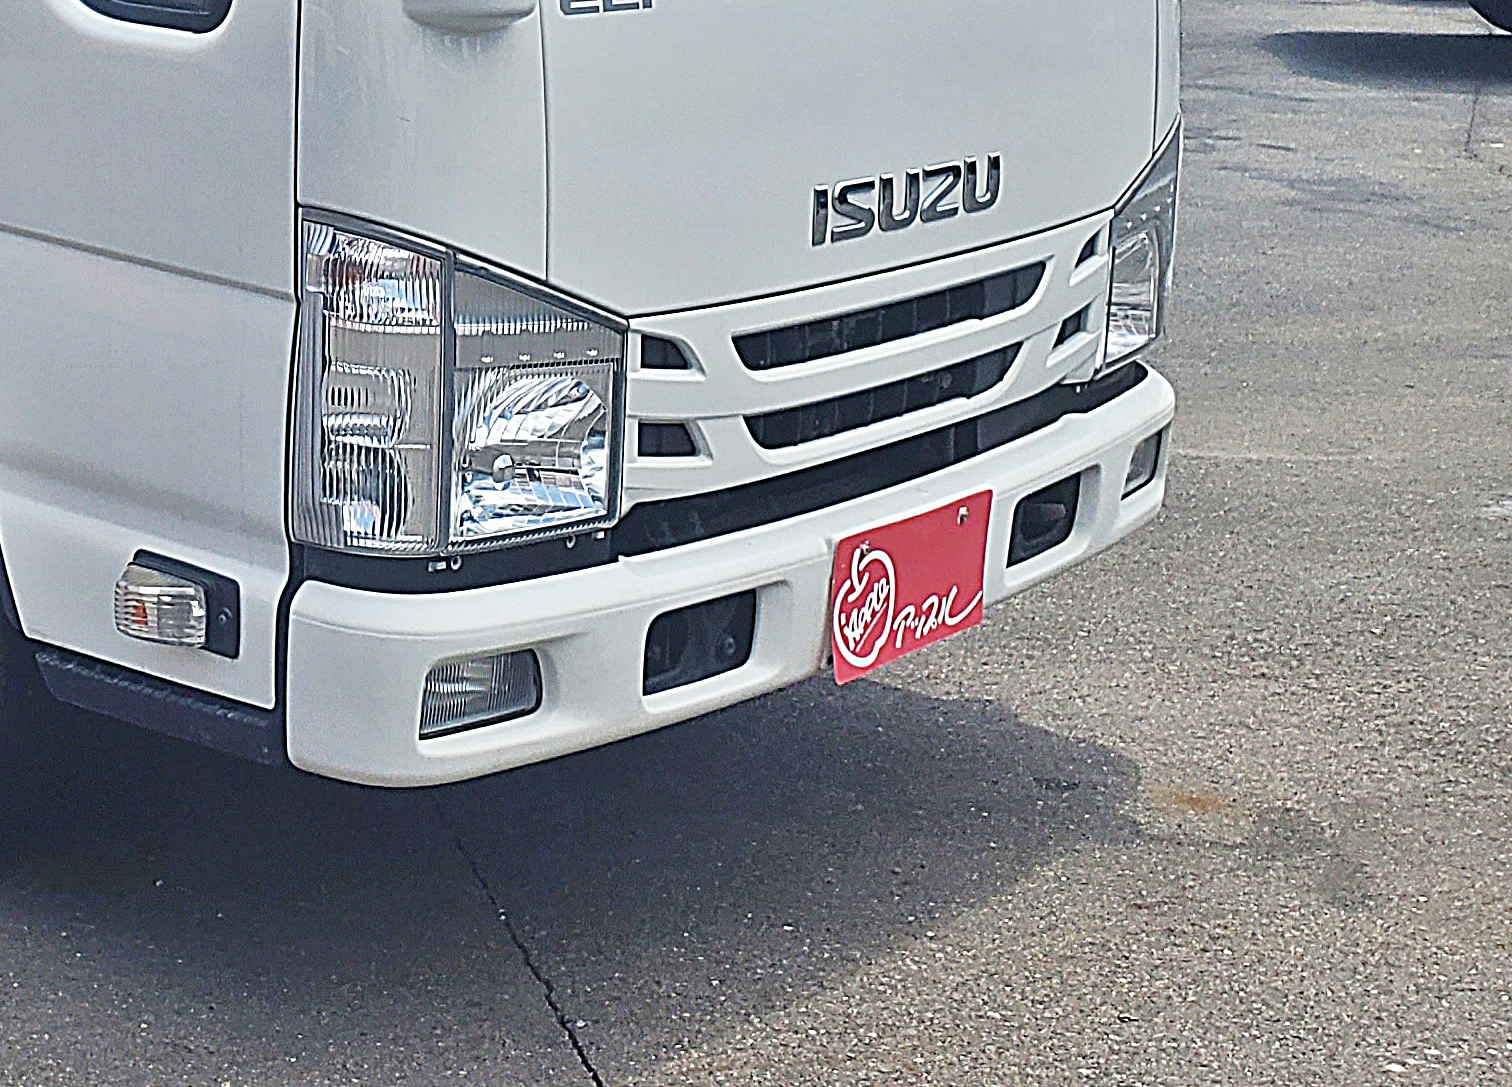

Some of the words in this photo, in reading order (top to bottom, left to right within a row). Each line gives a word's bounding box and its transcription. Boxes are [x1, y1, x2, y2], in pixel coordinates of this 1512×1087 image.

[812, 150, 1000, 246] ISUZU
[893, 585, 983, 648] アップル
